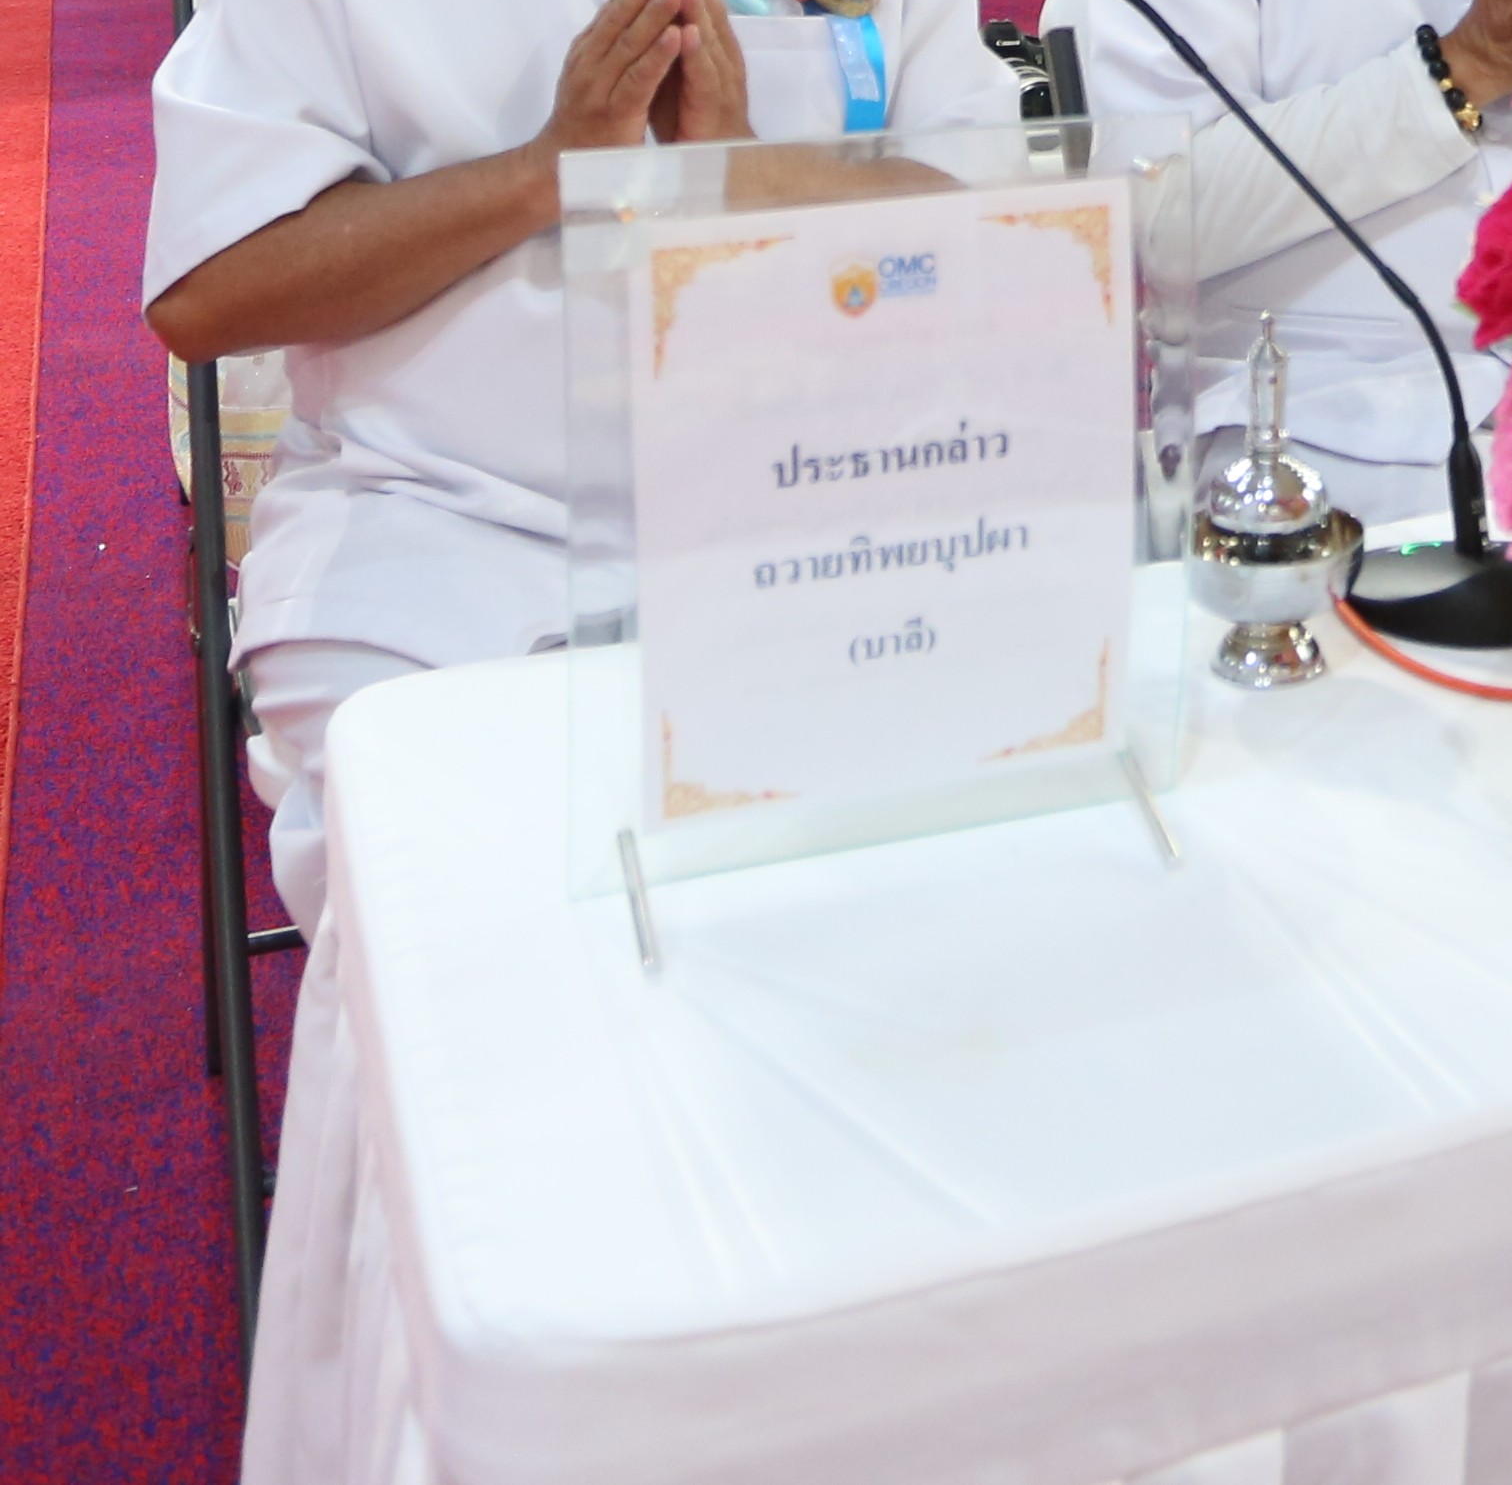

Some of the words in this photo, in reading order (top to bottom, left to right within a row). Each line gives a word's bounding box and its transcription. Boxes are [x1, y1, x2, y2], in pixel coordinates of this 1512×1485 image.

[878, 252, 936, 278] OMC
[771, 418, 1011, 489] ประธานกล่าว
[752, 516, 1030, 592] ถวายทิพยบุปผา
[848, 617, 937, 666] (บาลี)
